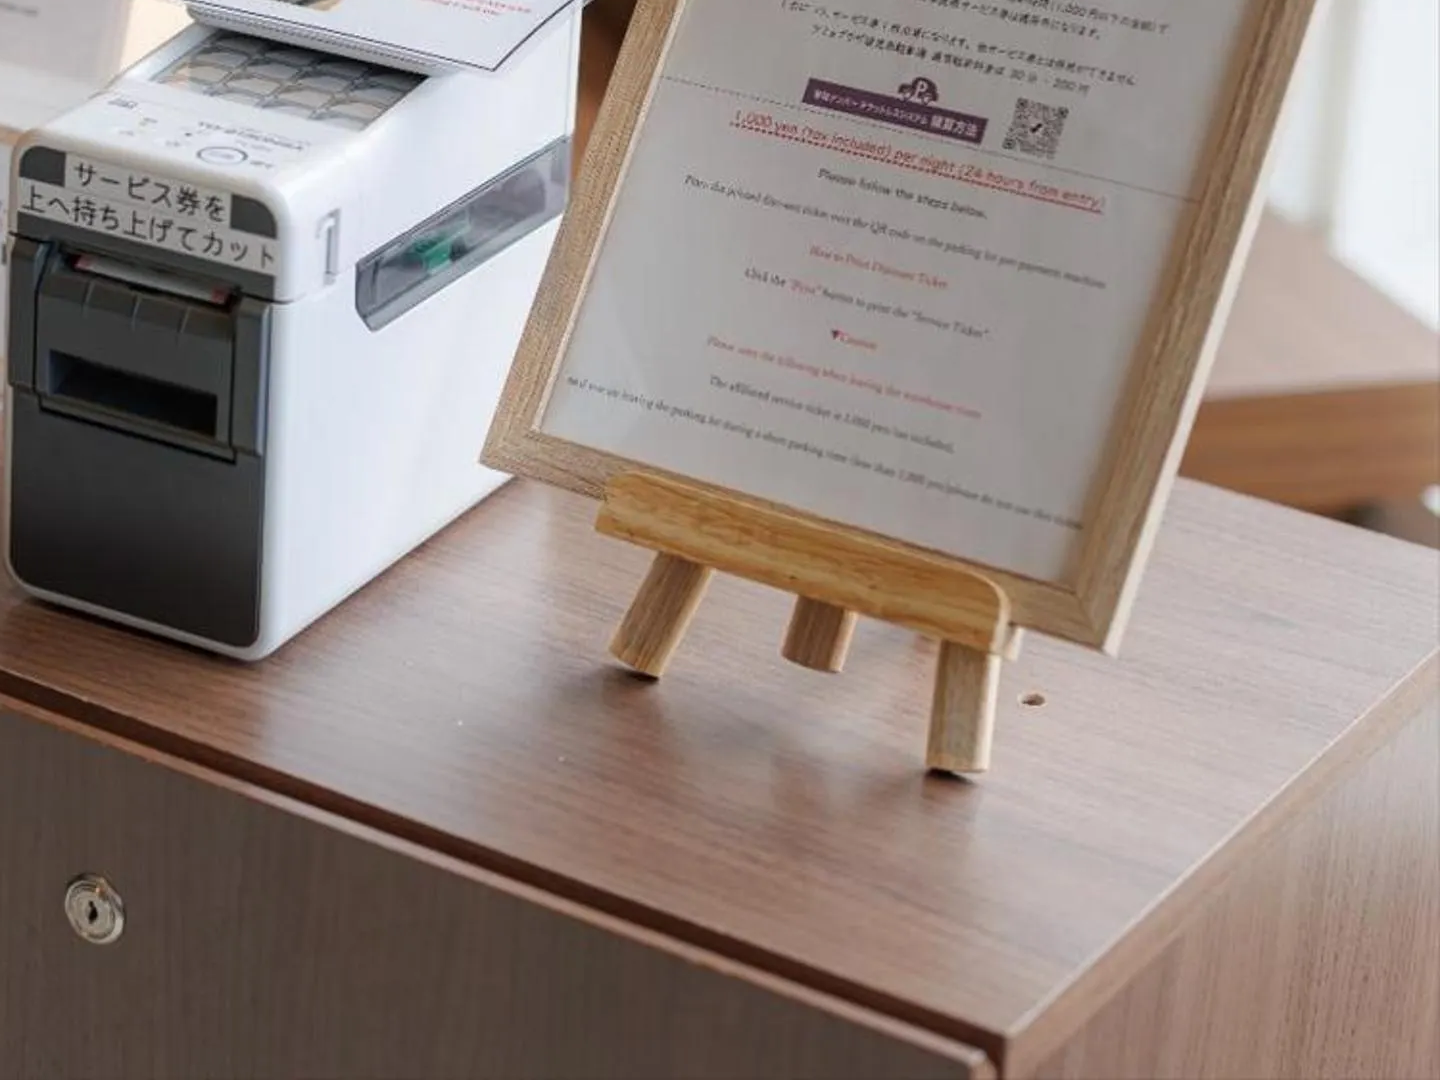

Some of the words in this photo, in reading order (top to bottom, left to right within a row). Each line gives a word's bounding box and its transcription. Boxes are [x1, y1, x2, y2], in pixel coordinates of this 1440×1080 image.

[736, 110, 773, 125] 1,000
[775, 120, 798, 134] yen
[831, 134, 892, 157] included)
[894, 149, 918, 164] per
[920, 154, 957, 174] night
[987, 170, 1024, 189] hours
[1029, 179, 1059, 197] from
[817, 168, 856, 186] Please
[895, 187, 913, 201] the
[22, 186, 276, 269] 上へ持ち上げてカット
[74, 163, 225, 223] サービス券を
